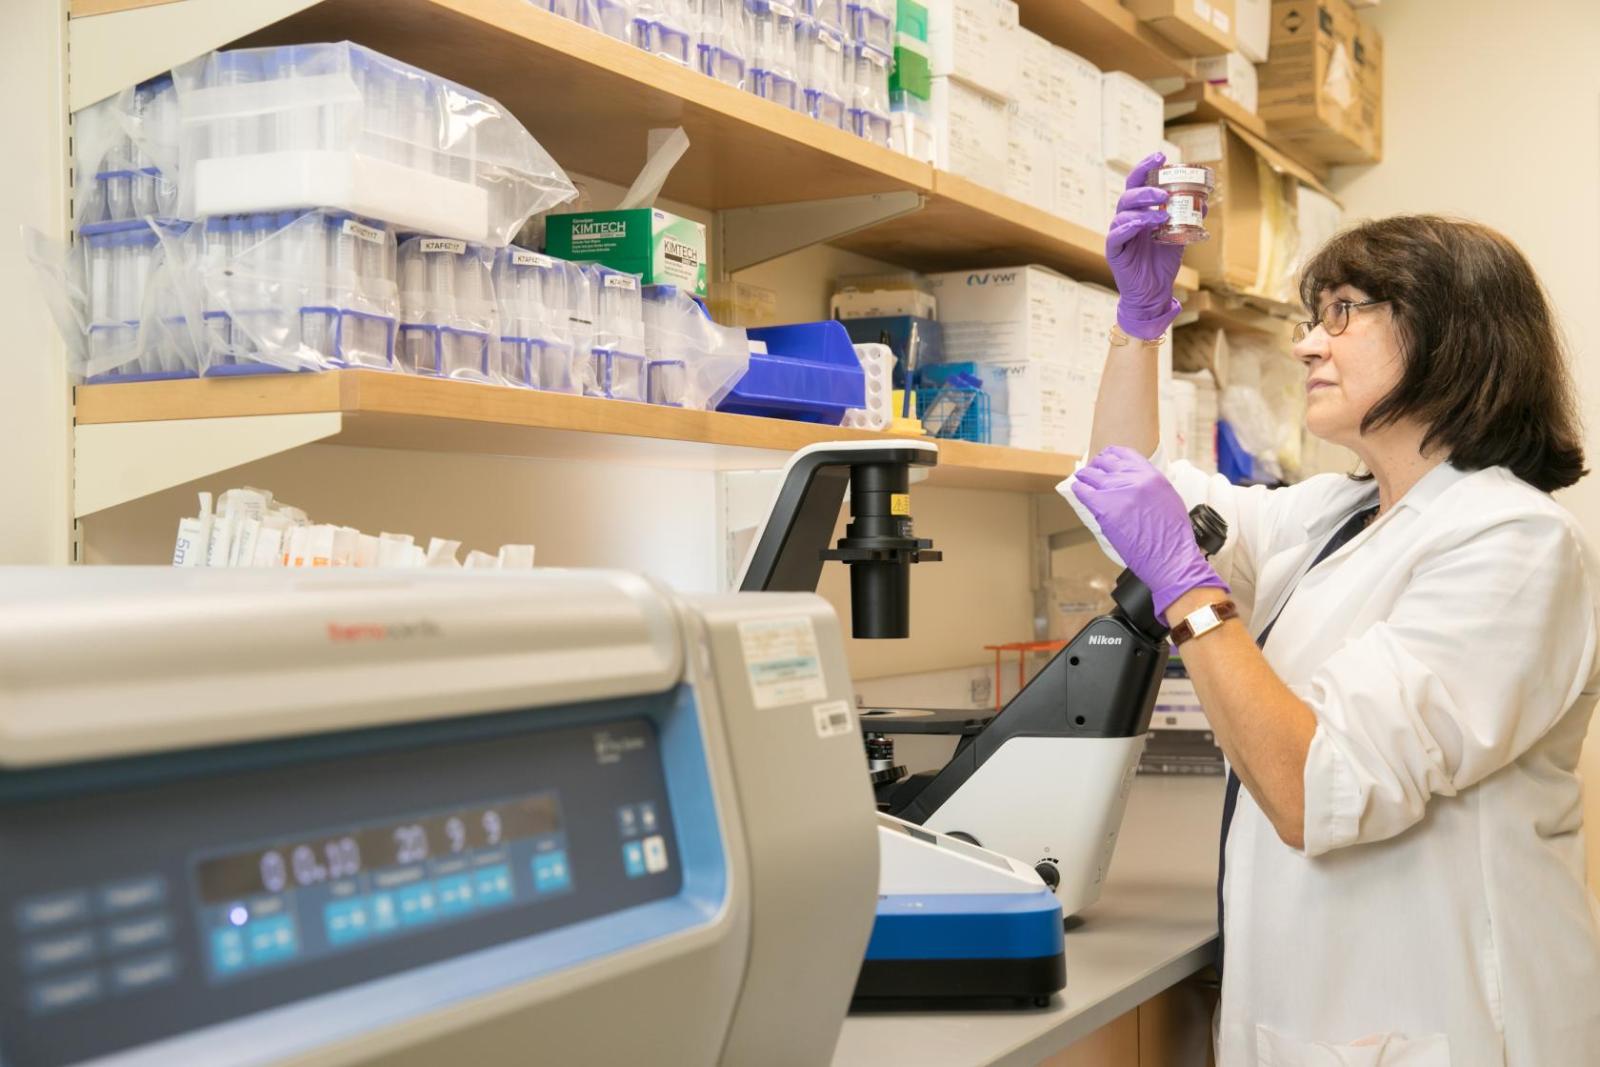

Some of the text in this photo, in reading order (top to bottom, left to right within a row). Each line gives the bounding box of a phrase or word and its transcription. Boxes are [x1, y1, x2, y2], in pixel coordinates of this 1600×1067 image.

[572, 221, 626, 234] KIMTECH
[664, 240, 698, 261] KIMTECH
[1088, 634, 1122, 645] Nikon
